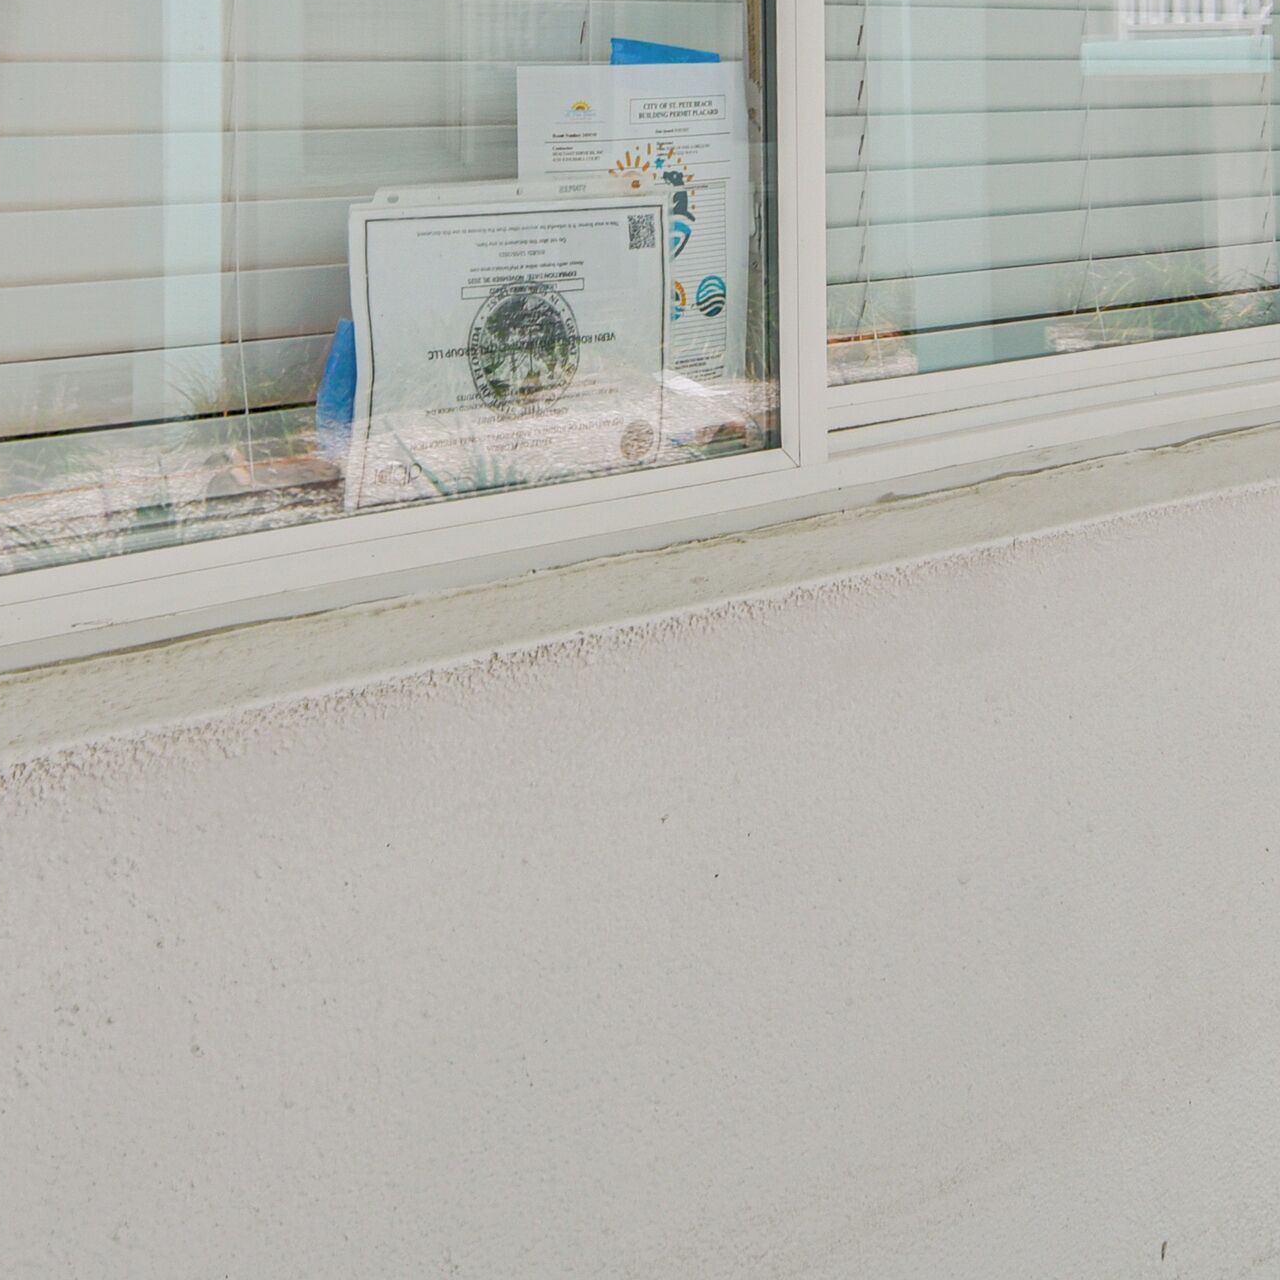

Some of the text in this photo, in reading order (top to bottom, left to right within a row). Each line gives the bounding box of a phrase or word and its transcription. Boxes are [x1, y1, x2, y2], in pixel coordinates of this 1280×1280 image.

[693, 100, 713, 108] BEACH
[638, 108, 719, 119] BUILDING PERMIT PLACARD
[492, 274, 525, 282] NOVEMBER
[544, 270, 577, 278] EXPIRATION
[594, 332, 616, 344] VERN
[427, 349, 444, 361] LLC
